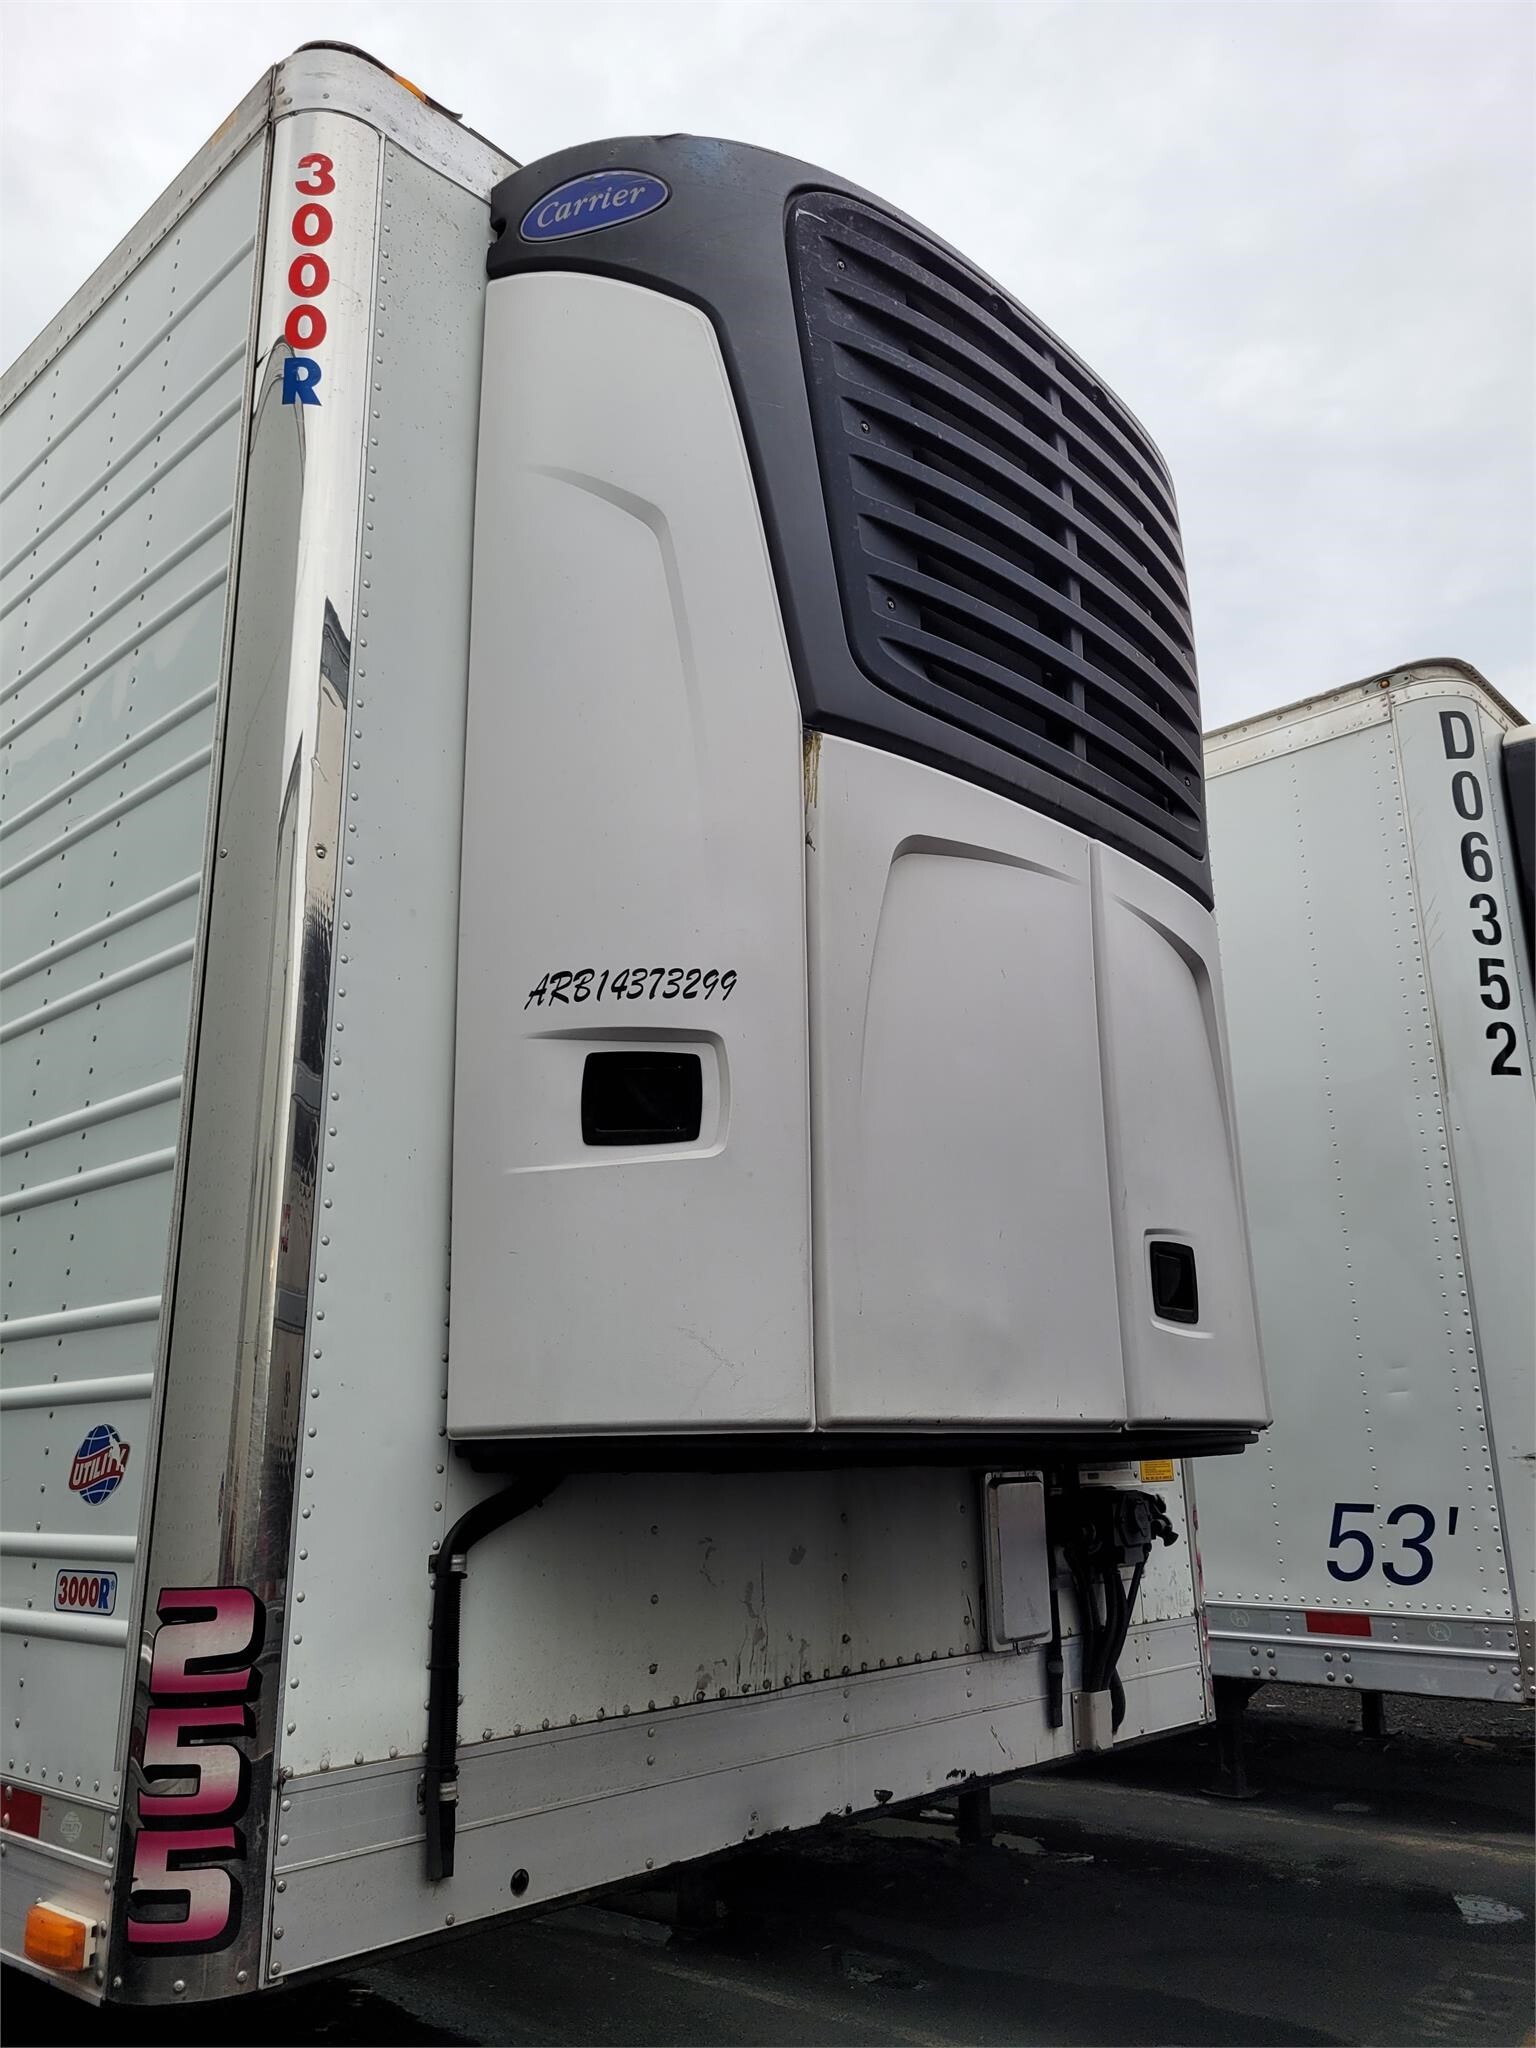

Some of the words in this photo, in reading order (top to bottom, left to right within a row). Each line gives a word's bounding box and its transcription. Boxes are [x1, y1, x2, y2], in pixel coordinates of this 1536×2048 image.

[281, 153, 335, 406] 3000R
[537, 186, 646, 228] Carrier
[524, 967, 738, 1010] ARB14373299
[1439, 711, 1522, 1076] D06352
[127, 1587, 266, 1956] 255
